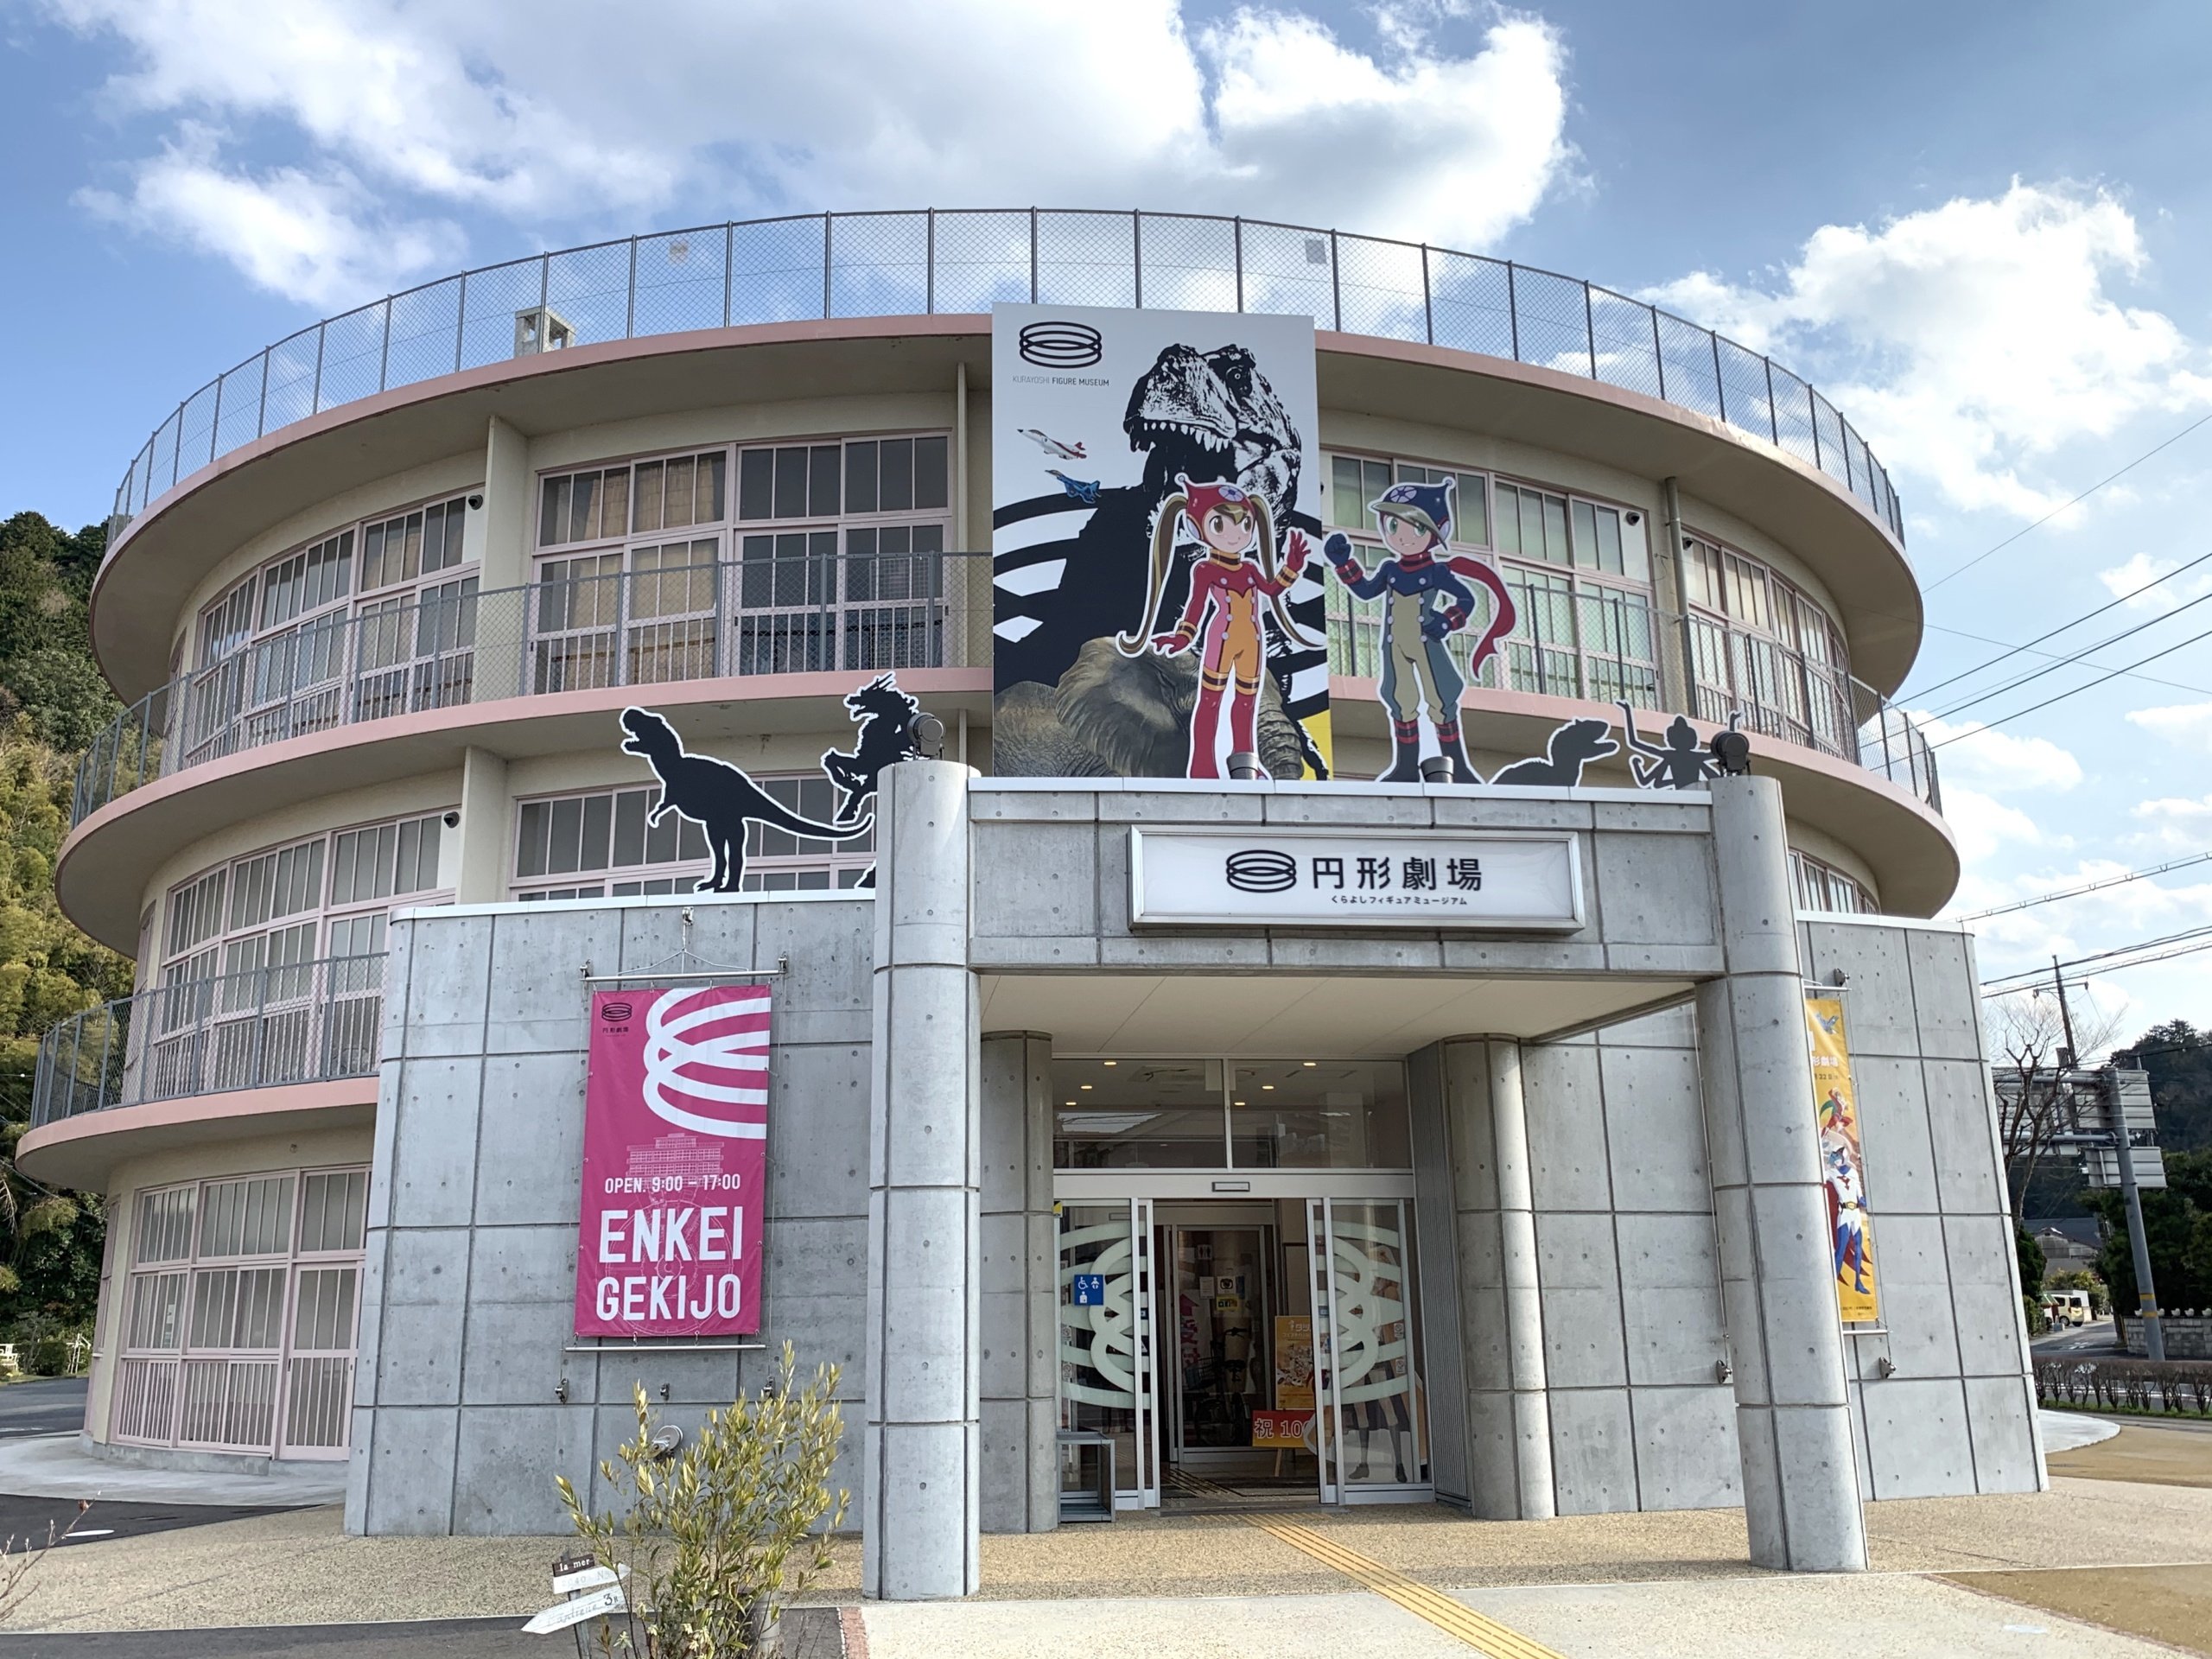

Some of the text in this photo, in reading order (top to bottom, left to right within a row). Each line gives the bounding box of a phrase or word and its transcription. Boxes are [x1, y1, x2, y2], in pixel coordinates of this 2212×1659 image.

[1012, 375, 1050, 385] KURAYOSHI
[1052, 377, 1077, 385] FIGURE
[1312, 856, 1482, 892] 円形劇場
[1331, 895, 1467, 906] くらよしフィギュアミュージアム
[605, 1178, 646, 1194] OPEN.
[652, 1176, 683, 1192] 9:00
[702, 1173, 741, 1191] 17:00
[599, 1206, 743, 1263] ENKEI
[596, 1274, 741, 1321] GEKIJO
[1254, 1417, 1274, 1439] 祝
[559, 1559, 590, 1572] la mer
